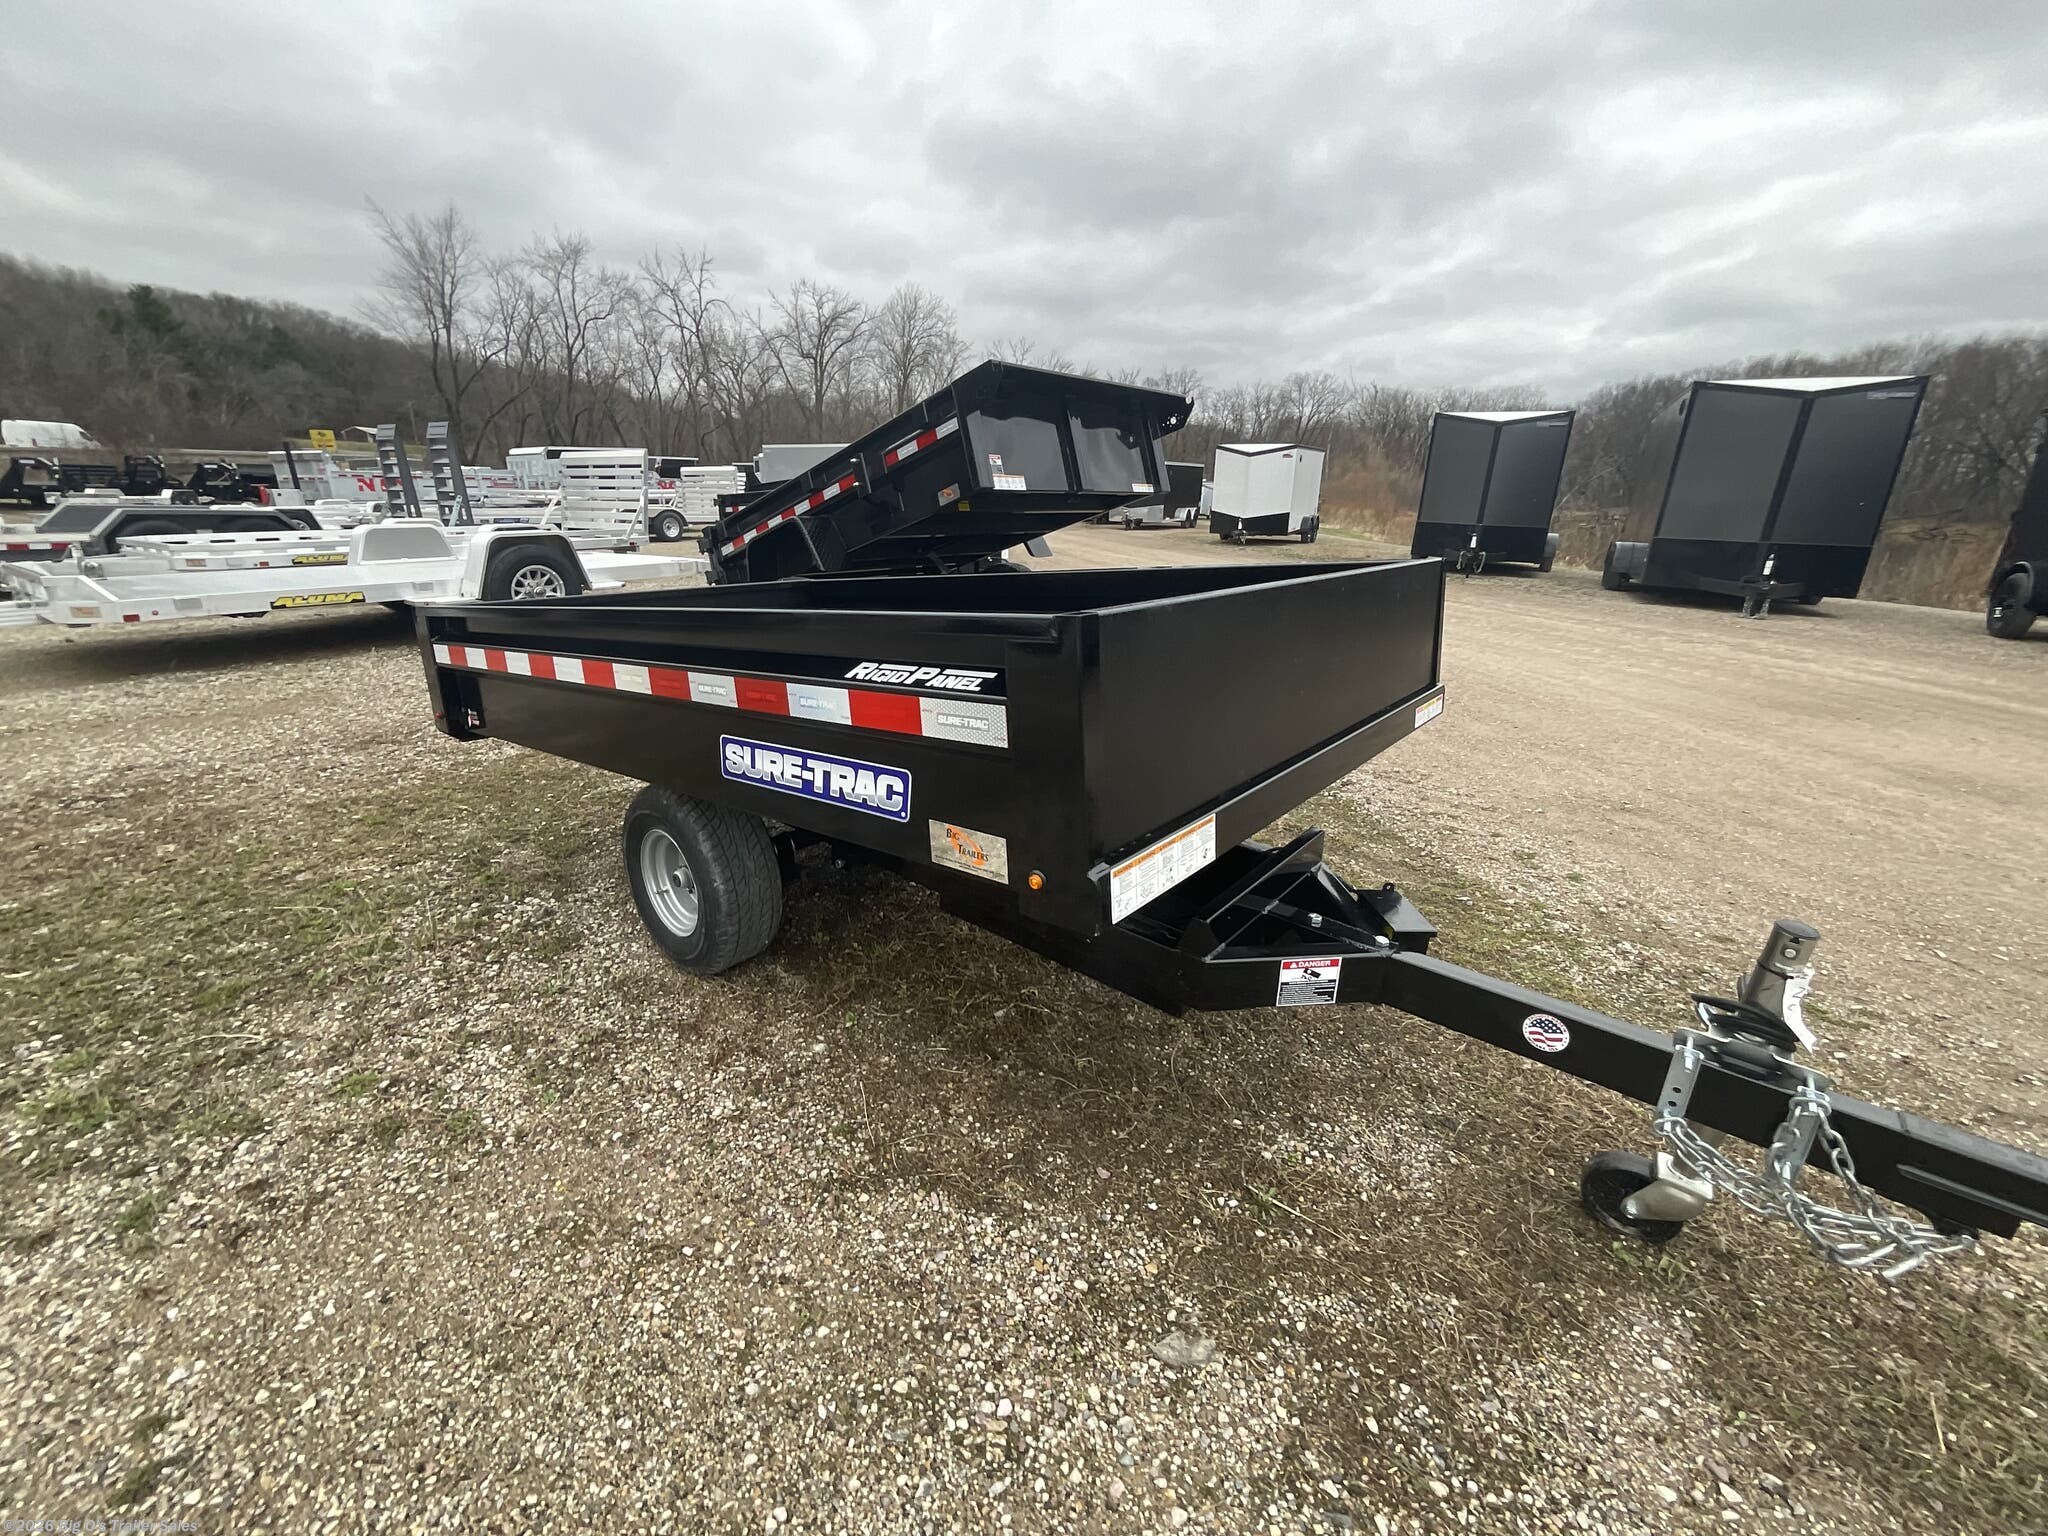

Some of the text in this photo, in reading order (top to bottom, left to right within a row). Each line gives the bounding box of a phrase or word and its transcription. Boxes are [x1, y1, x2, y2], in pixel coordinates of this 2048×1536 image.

[293, 554, 348, 564] ALUM
[271, 591, 365, 609] ALUMA
[937, 714, 990, 730] SURE-TRAC
[725, 743, 904, 812] SURE-TRAC
[1298, 960, 1332, 968] DANGER
